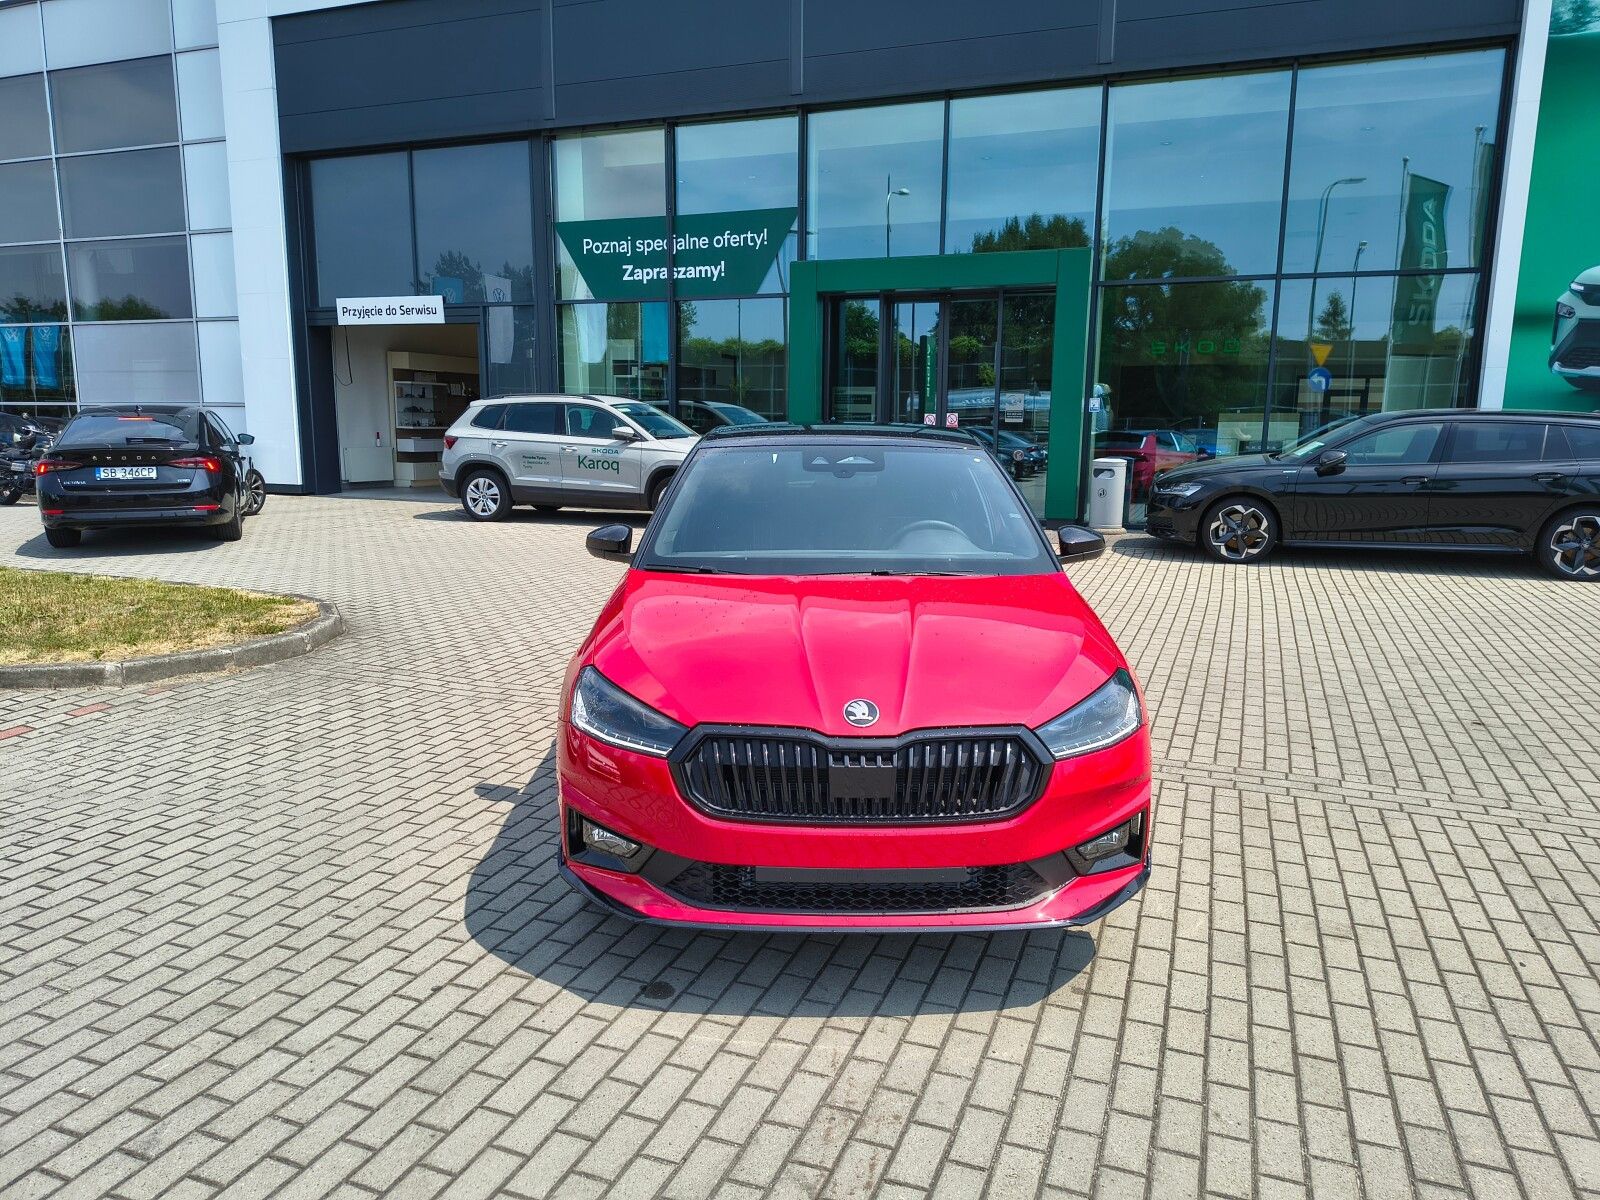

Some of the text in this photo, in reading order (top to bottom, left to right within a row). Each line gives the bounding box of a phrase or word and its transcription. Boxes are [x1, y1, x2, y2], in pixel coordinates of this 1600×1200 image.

[583, 227, 768, 257] Poznaj specjalne oferty!
[621, 260, 726, 284] Zapraszamy!
[341, 303, 438, 319] Przyjęcie do Serwisu
[102, 467, 155, 478] SB 346CP
[577, 455, 620, 475] Karoq
